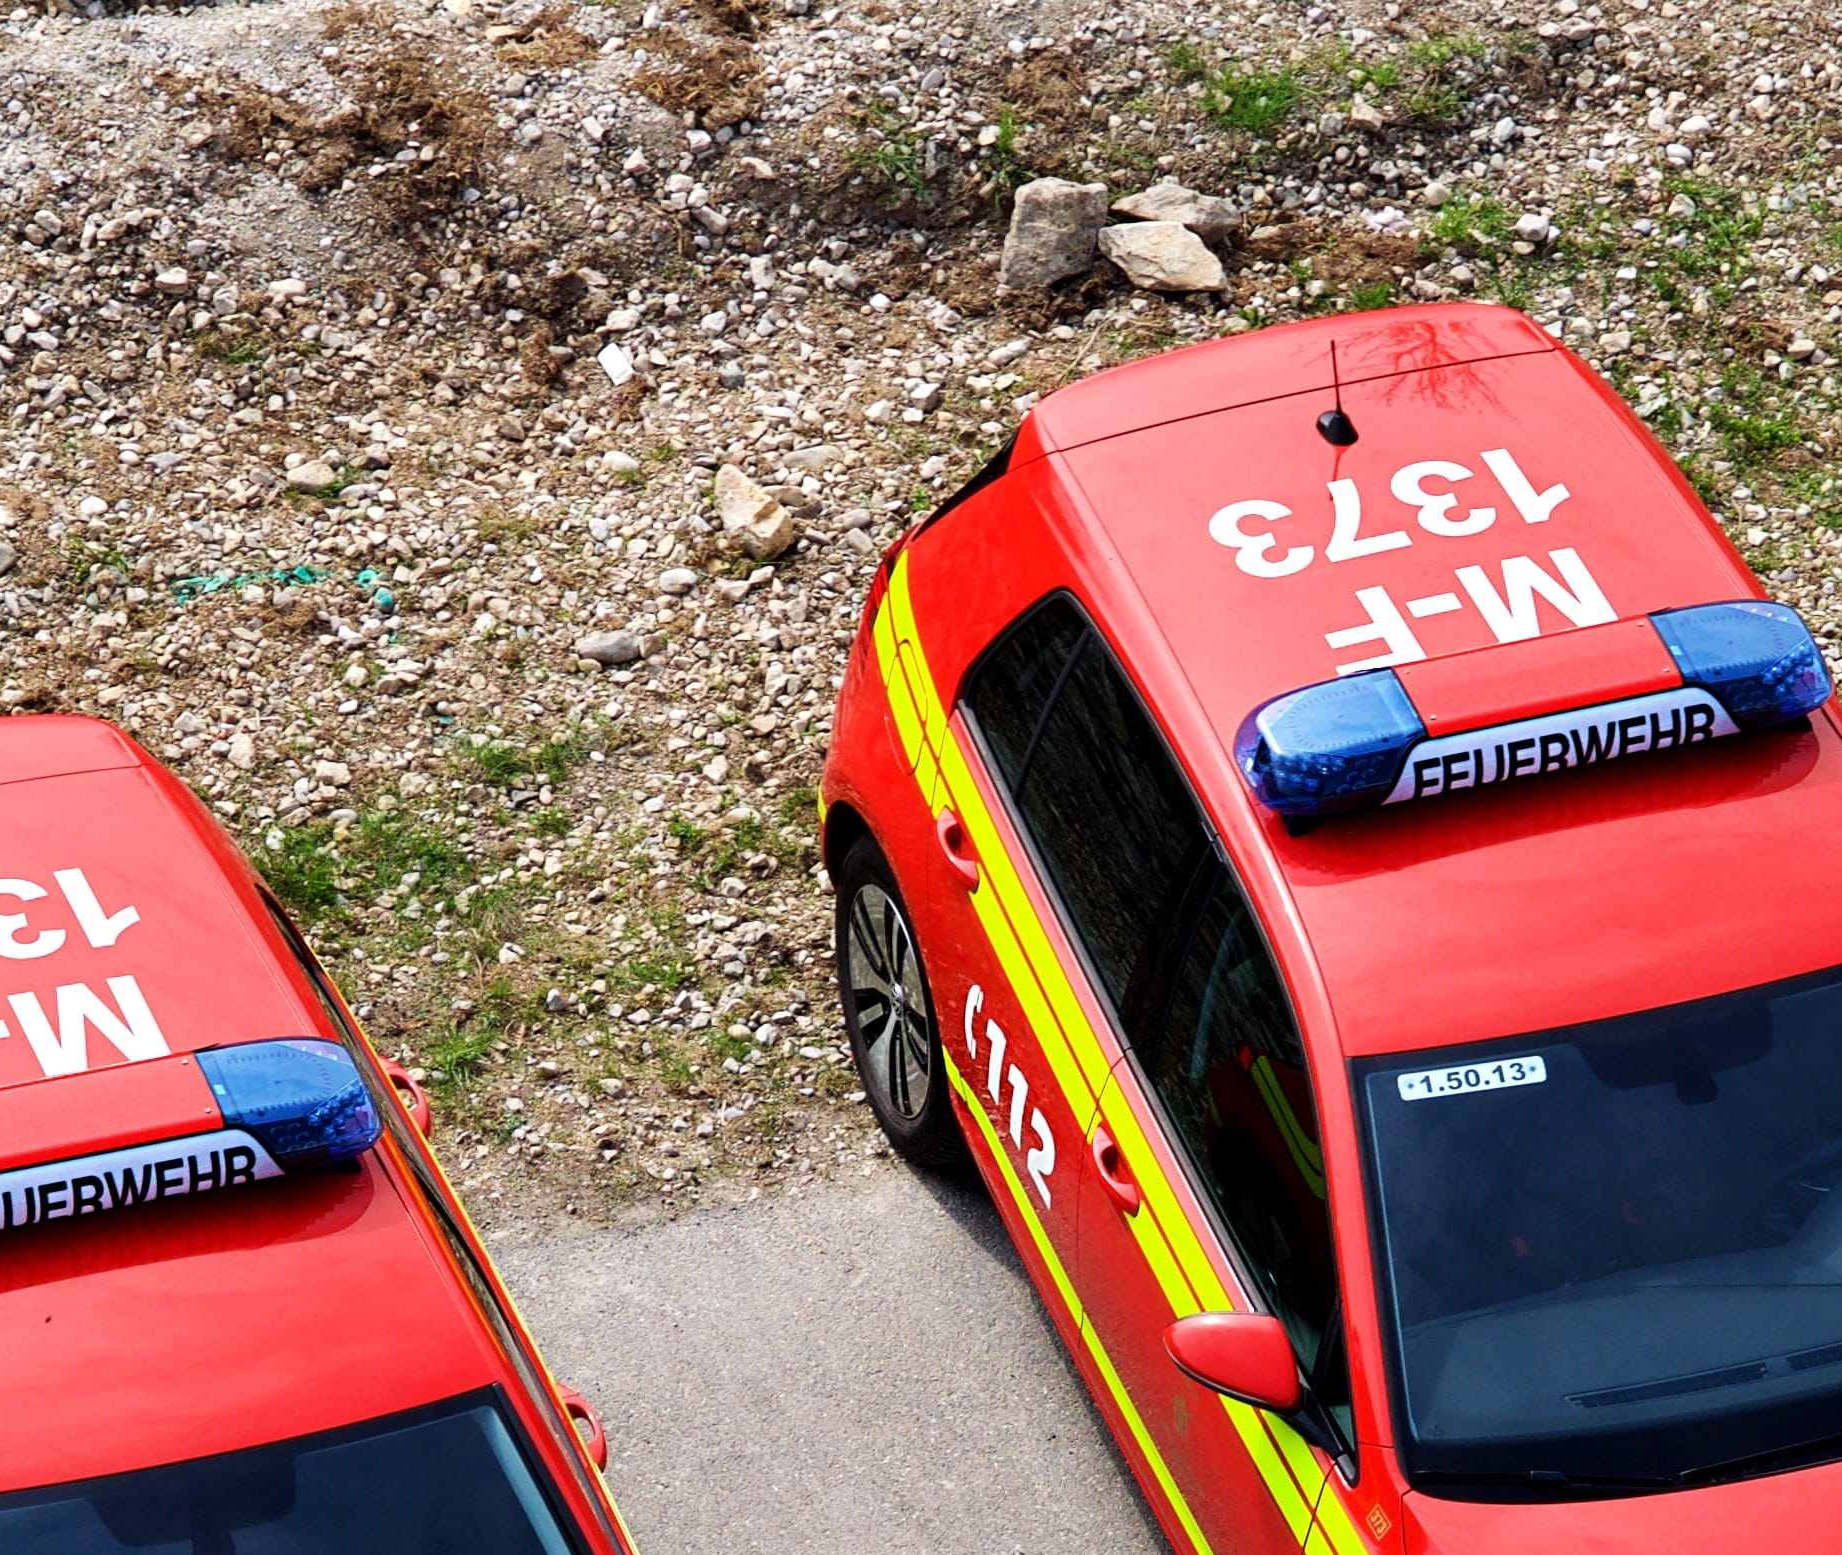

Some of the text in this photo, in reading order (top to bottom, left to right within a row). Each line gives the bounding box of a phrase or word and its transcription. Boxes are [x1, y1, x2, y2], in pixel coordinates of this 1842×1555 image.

[1208, 447, 1571, 579] 1373
[1324, 546, 1620, 677] M-F
[986, 1018, 1055, 1211] 112
[1419, 1062, 1527, 1094] 1.50.13
